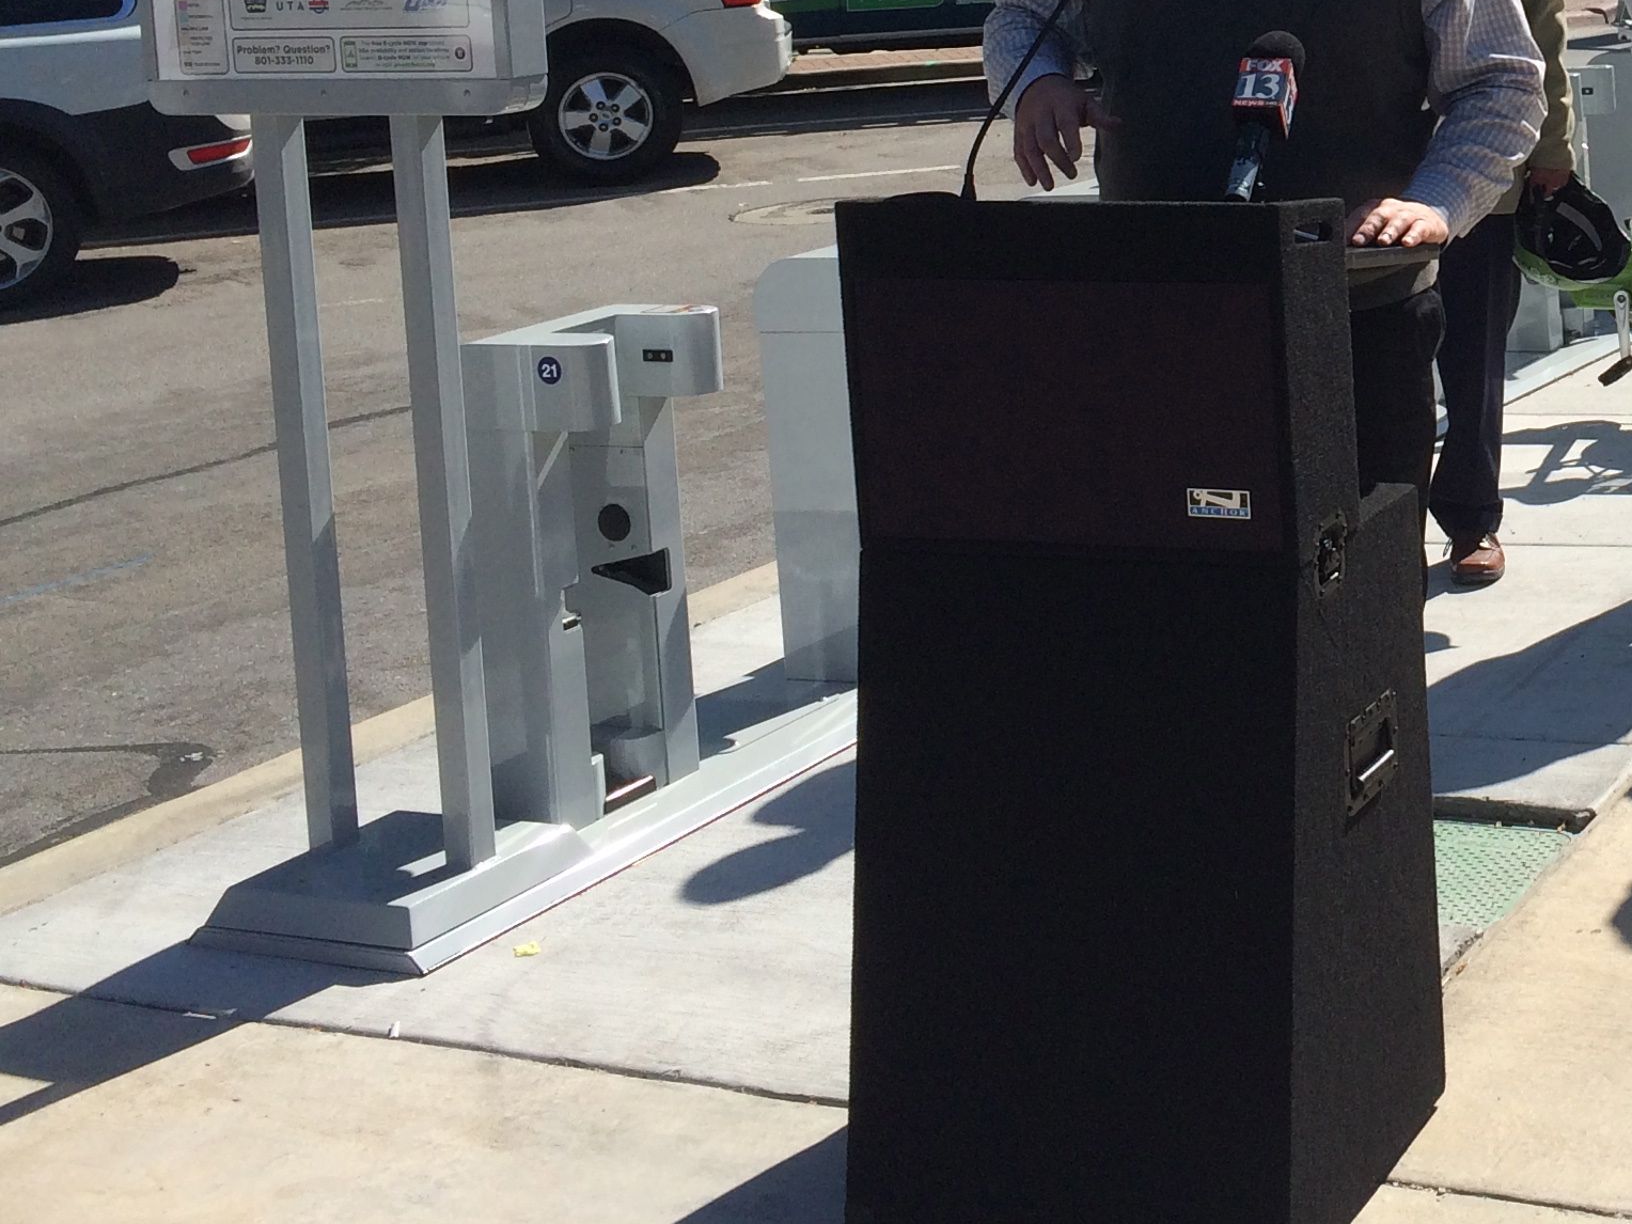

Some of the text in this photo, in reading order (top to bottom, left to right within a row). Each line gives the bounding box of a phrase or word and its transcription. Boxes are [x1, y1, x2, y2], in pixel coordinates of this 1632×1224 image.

[236, 44, 331, 55] Problem? Question?
[1245, 58, 1284, 72] FOX
[1236, 73, 1281, 99] 13
[1233, 99, 1265, 107] NEWS
[540, 363, 558, 379] 21
[1191, 507, 1248, 517] ANCHOR
